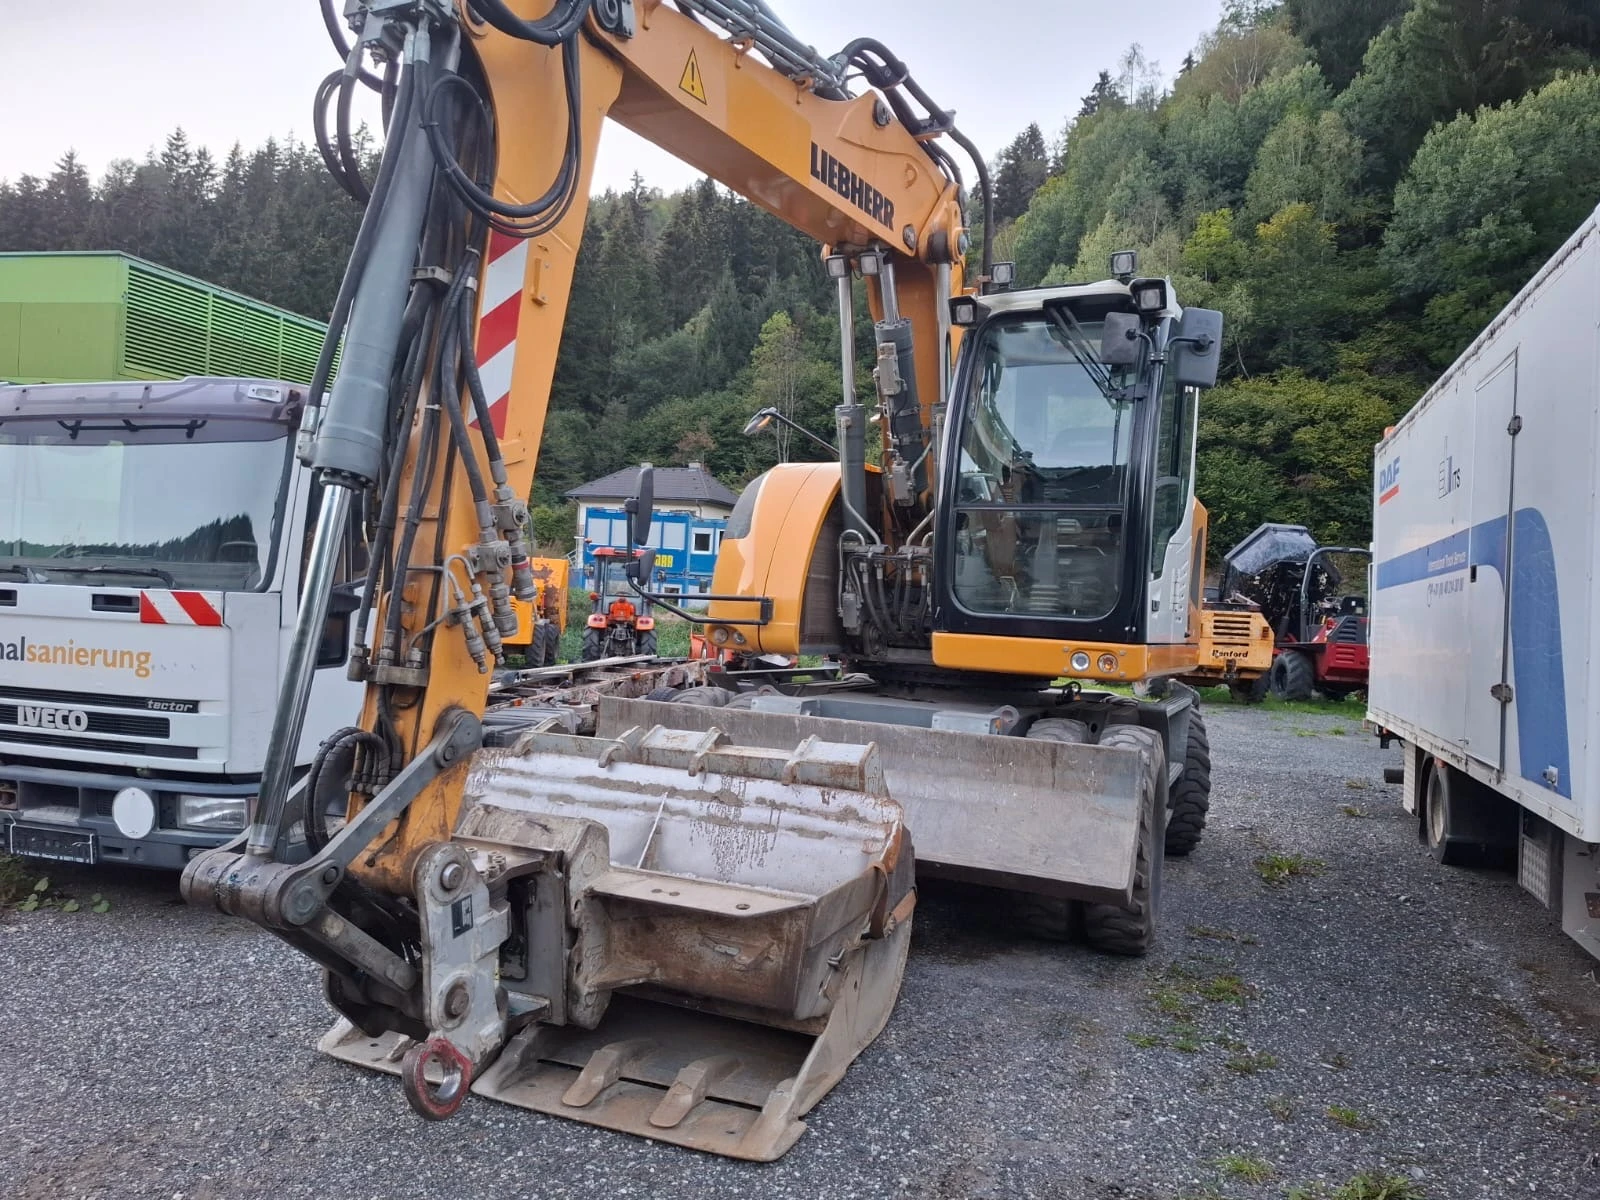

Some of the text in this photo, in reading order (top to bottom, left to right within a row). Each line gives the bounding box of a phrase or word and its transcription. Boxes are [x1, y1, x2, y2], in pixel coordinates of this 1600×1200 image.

[811, 141, 895, 232] LIEBHERR
[1379, 455, 1400, 493] DAF
[18, 705, 88, 732] IVECO
[148, 700, 193, 712] tector
